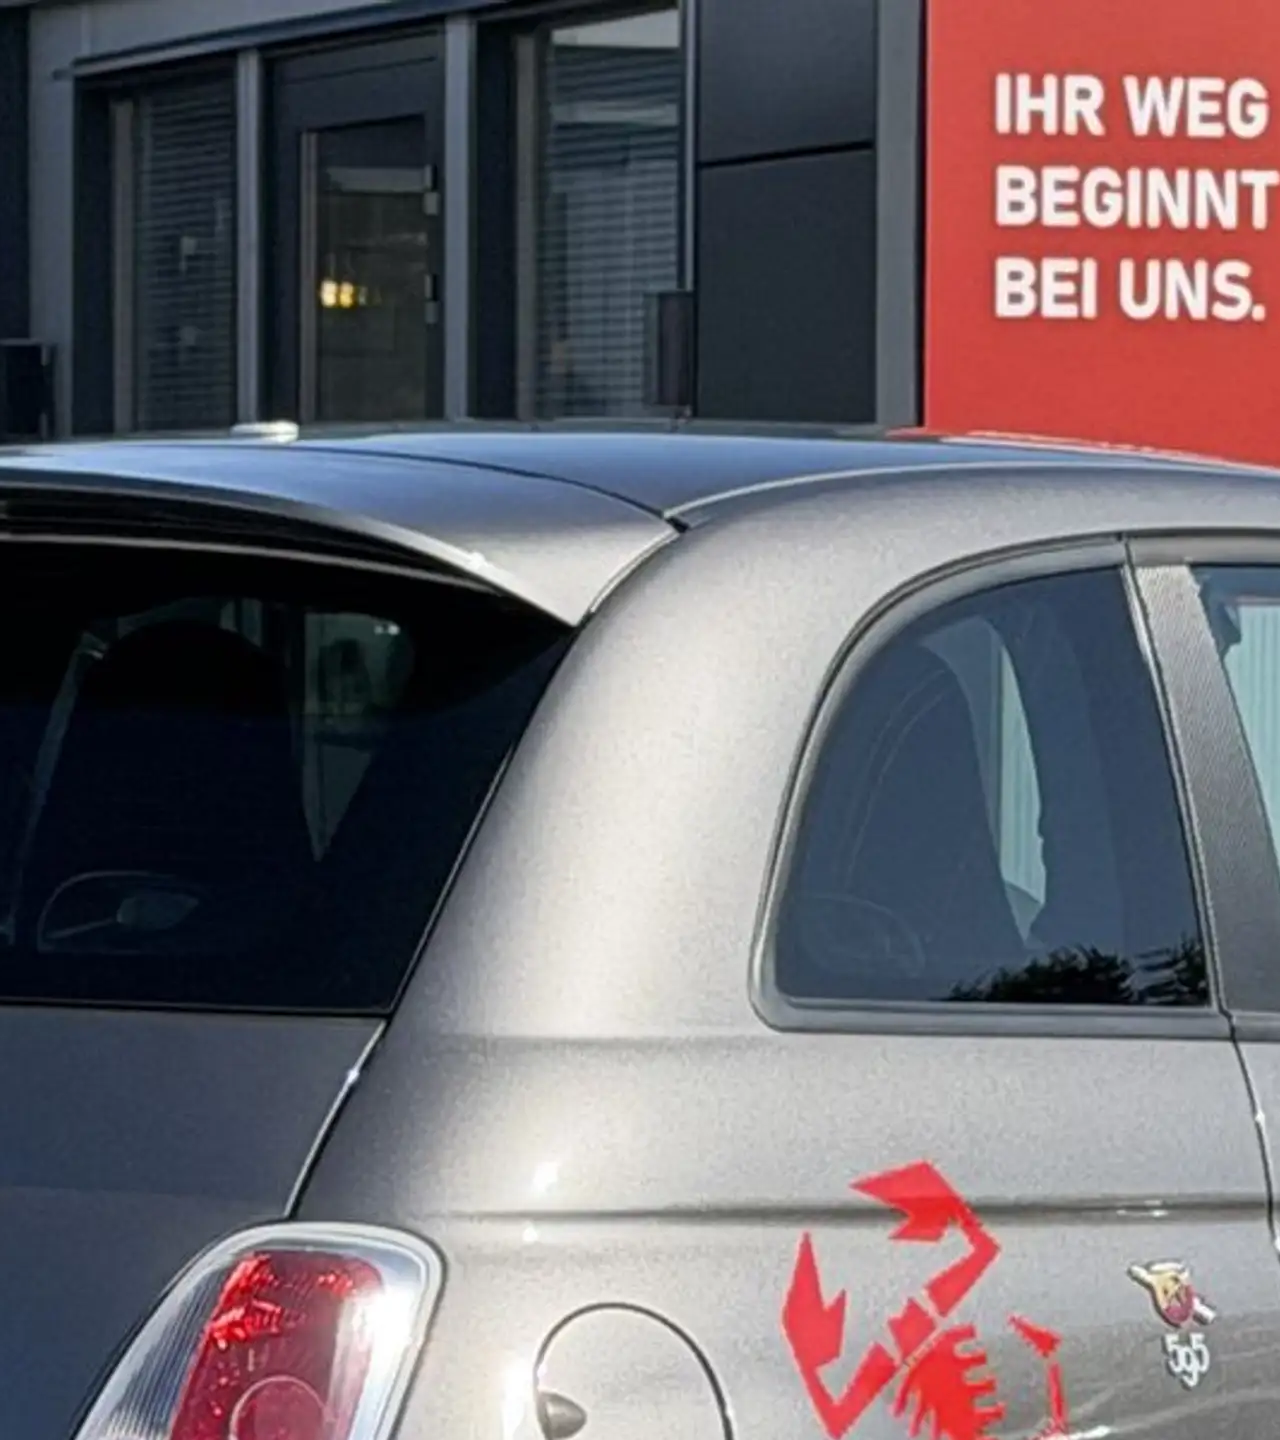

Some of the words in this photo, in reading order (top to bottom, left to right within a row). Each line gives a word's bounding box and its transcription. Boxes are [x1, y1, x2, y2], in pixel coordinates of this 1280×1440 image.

[995, 73, 1104, 136] IHR
[1123, 76, 1269, 138] WEG
[996, 165, 1280, 229] BEGINNT
[995, 257, 1097, 318] BEI
[1119, 259, 1266, 321] UNS.
[1164, 1332, 1210, 1387] 595
